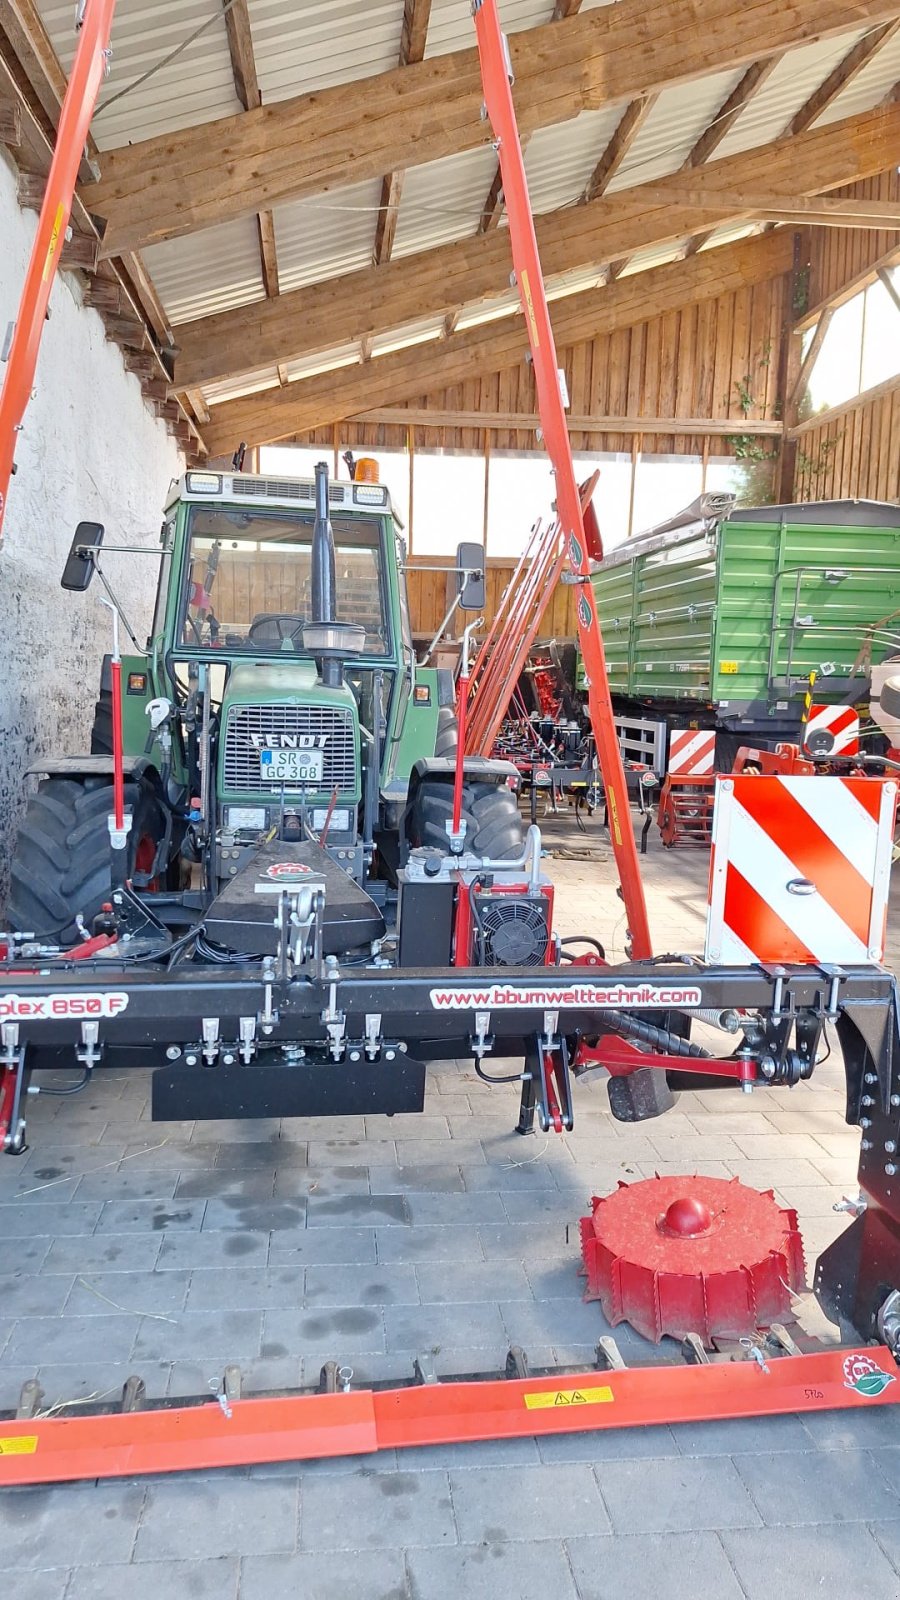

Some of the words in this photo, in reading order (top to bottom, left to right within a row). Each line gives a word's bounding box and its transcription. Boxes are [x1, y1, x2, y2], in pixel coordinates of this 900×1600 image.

[251, 733, 331, 748] FENDT
[278, 752, 297, 765] SR
[266, 766, 286, 778] GC
[289, 766, 317, 779] 308
[435, 988, 699, 1005] www.bbumwelttechnik.com
[52, 999, 102, 1014] 850
[109, 998, 124, 1013] F
